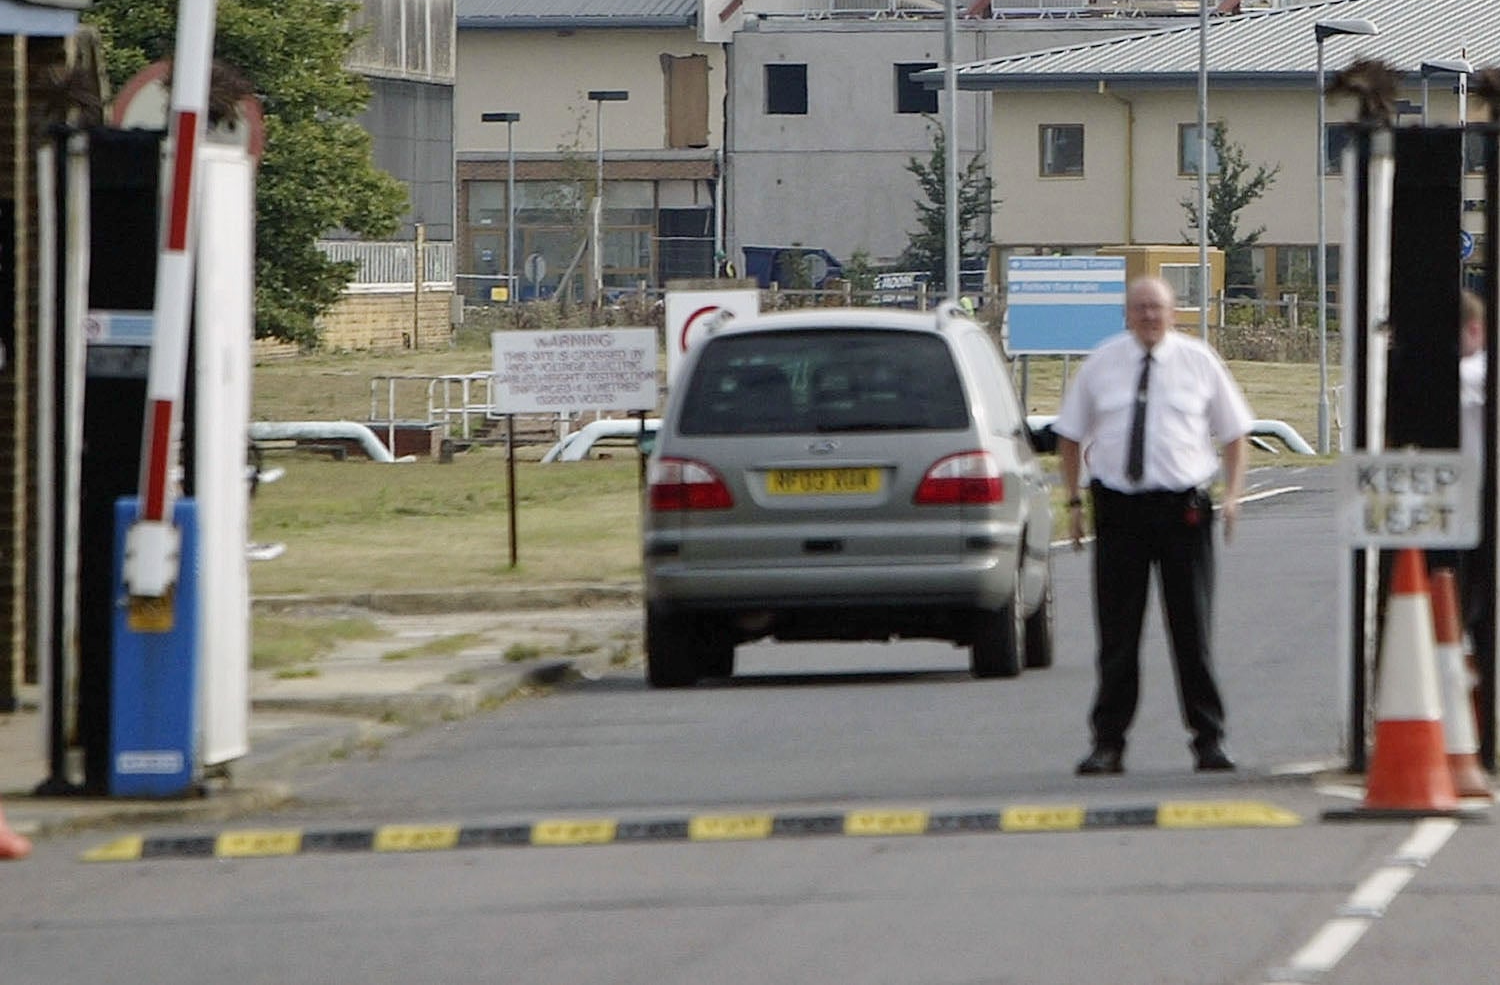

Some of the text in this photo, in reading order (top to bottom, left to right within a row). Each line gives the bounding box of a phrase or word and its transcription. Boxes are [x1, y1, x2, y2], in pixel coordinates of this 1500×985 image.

[534, 333, 615, 348] WARNING
[571, 349, 626, 361] CROSSED
[588, 360, 641, 372] ELECTRIC
[539, 372, 582, 382] HEIGHT
[585, 369, 655, 382] RESTRICTION
[592, 382, 640, 393] METRES
[579, 393, 616, 405] VOLTS
[1357, 464, 1457, 494] KEEP
[1363, 505, 1453, 535] LEFT
